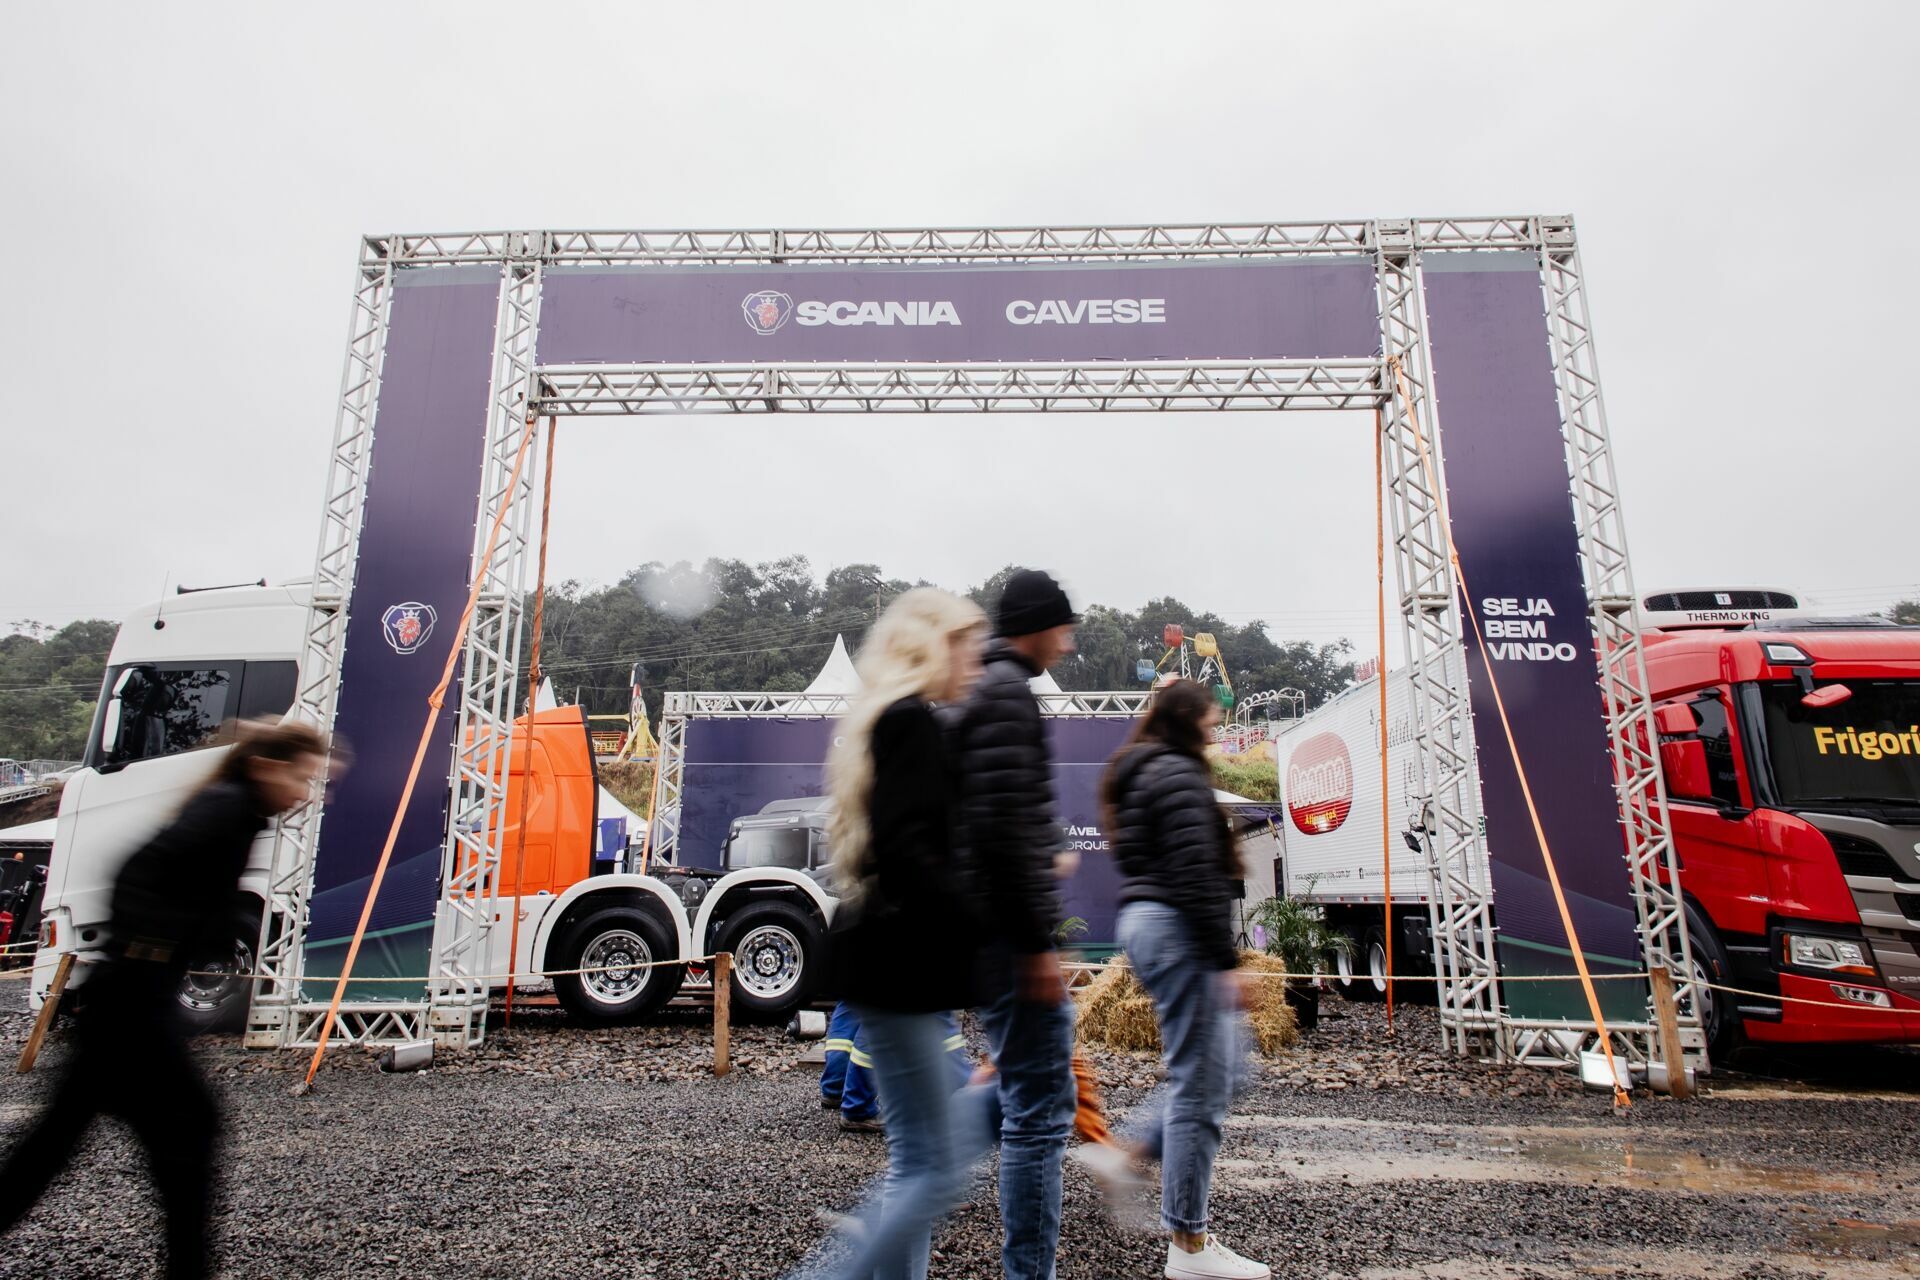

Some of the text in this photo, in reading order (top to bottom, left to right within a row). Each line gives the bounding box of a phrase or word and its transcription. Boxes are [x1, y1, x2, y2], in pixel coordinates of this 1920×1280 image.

[795, 298, 1166, 327] SCANIA CAVESE
[1482, 597, 1556, 617] SEJA
[1686, 612, 1739, 622] THERMO
[1484, 620, 1547, 638] BEM
[1486, 642, 1577, 662] VINDO
[1813, 724, 1920, 760] Frigorí
[1061, 824, 1101, 837] TÁVEL
[1065, 840, 1111, 851] ORQUE
